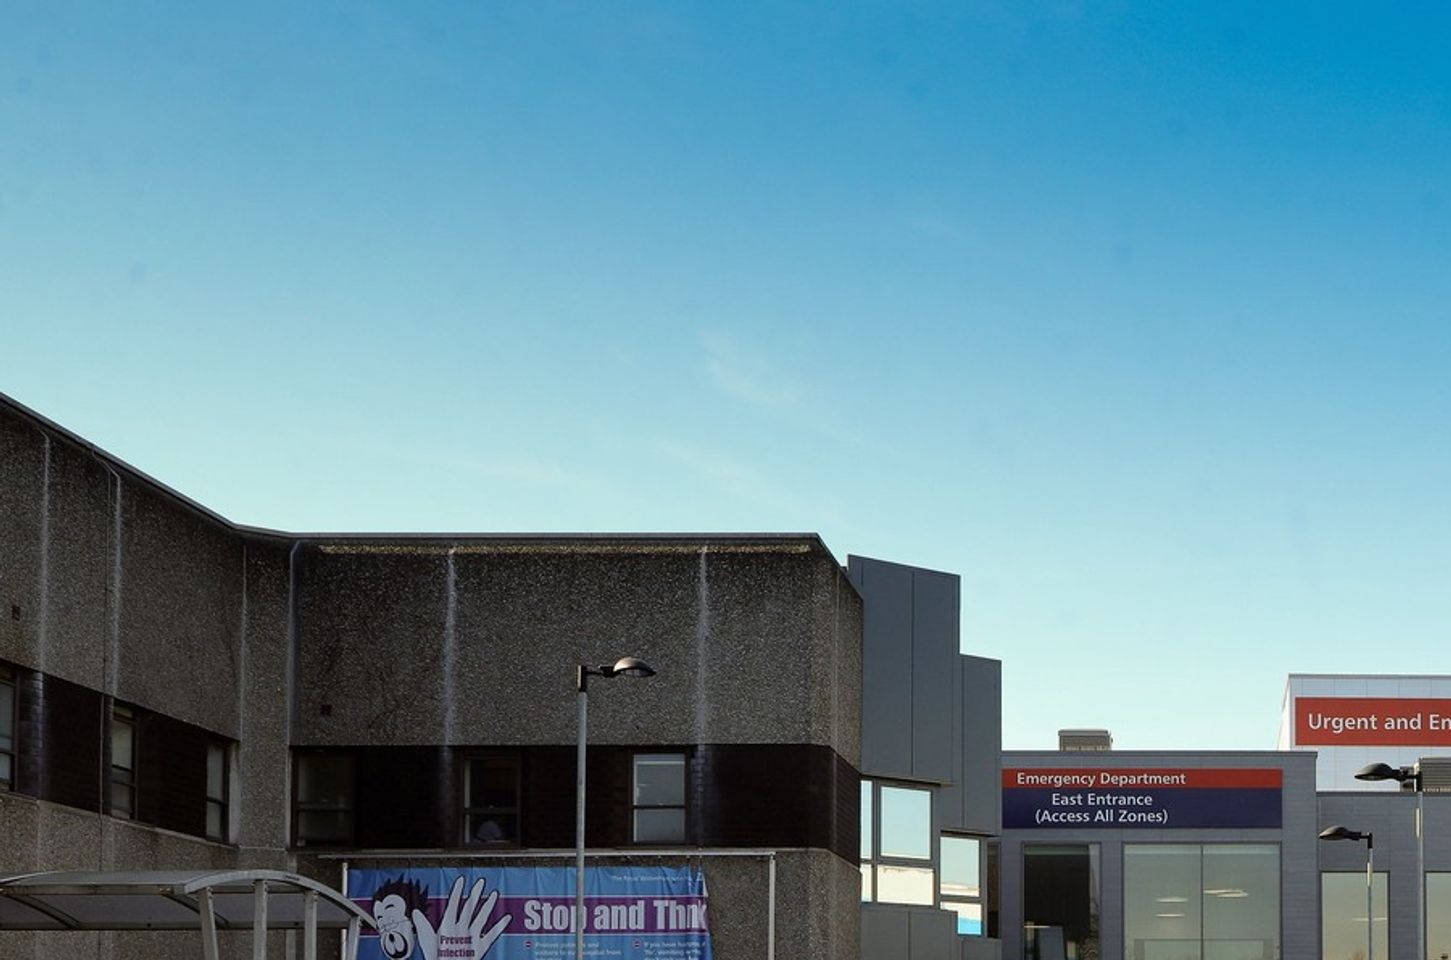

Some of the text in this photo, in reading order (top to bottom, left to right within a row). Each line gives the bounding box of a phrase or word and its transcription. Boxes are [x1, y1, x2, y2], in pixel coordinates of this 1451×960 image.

[1308, 713, 1377, 732] Urgent
[1384, 714, 1421, 730] and
[1017, 772, 1186, 787] Emergency Department
[1052, 793, 1153, 806] East Entrance
[1035, 809, 1168, 824] (Access All Zones)
[524, 900, 588, 932] Stop
[594, 900, 645, 930] and
[440, 935, 472, 944] Prevent
[437, 948, 475, 957] Infection
